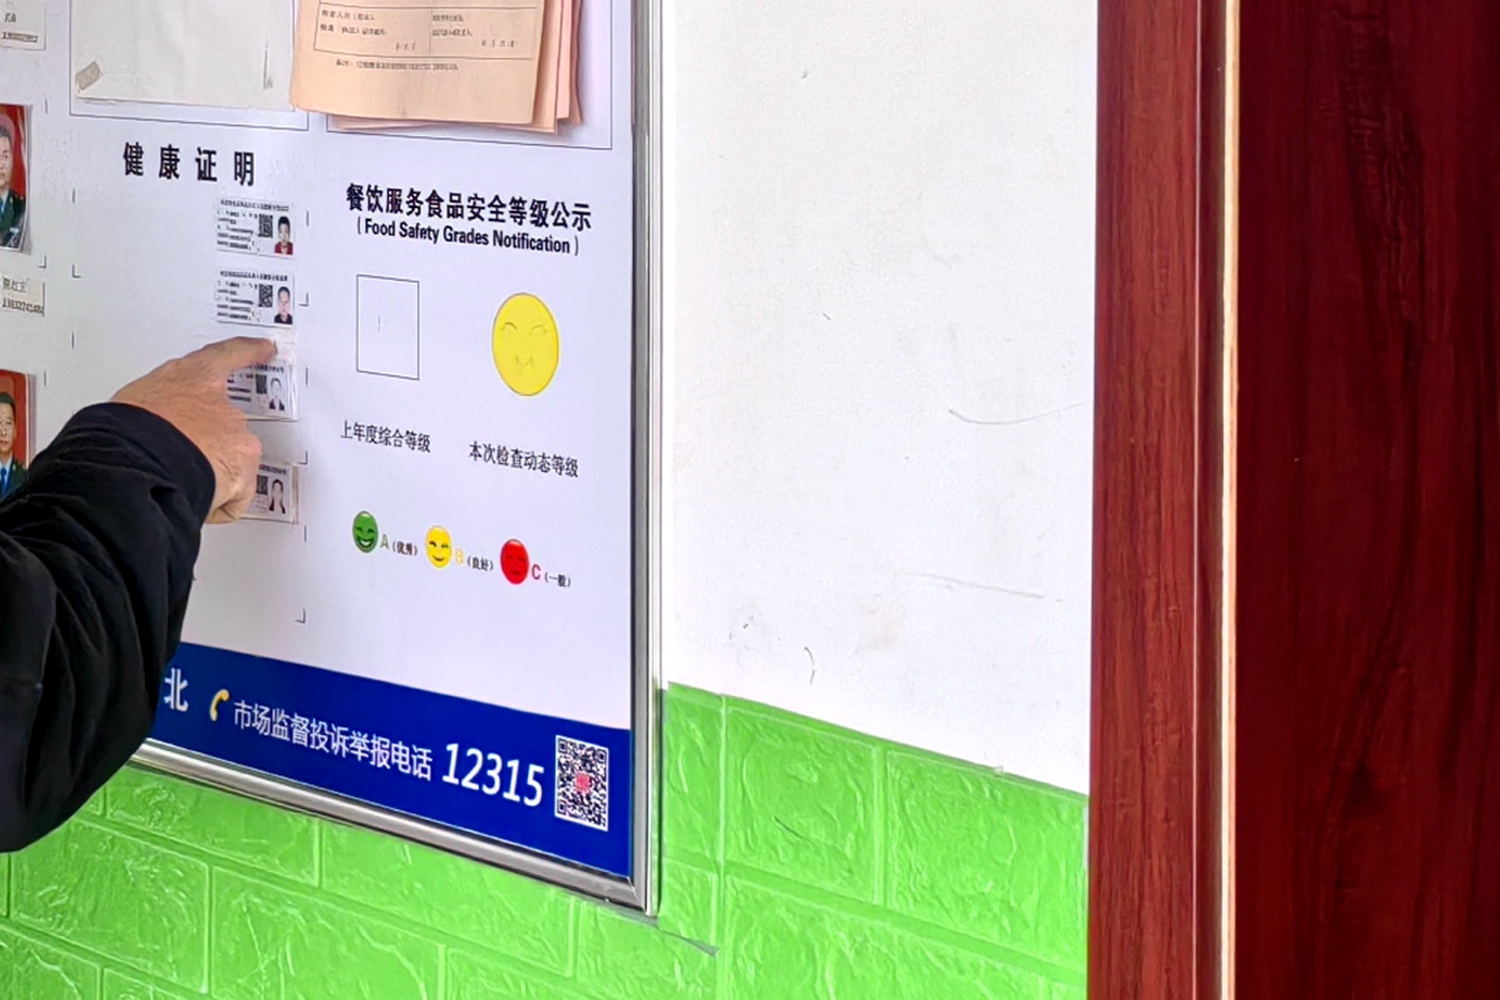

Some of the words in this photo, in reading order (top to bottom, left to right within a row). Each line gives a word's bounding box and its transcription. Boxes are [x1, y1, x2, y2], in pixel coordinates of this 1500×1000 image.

[123, 142, 255, 187] 健康证明
[345, 182, 593, 232] 餐饮服务食品安全等级公示
[399, 221, 440, 245] Safety
[443, 225, 490, 246] Grades
[340, 420, 431, 454] 上年度综合等级
[469, 440, 579, 479] 本次检查动态等级
[233, 699, 433, 782] 市场监督投诉举报电话
[442, 741, 545, 808] 12315
